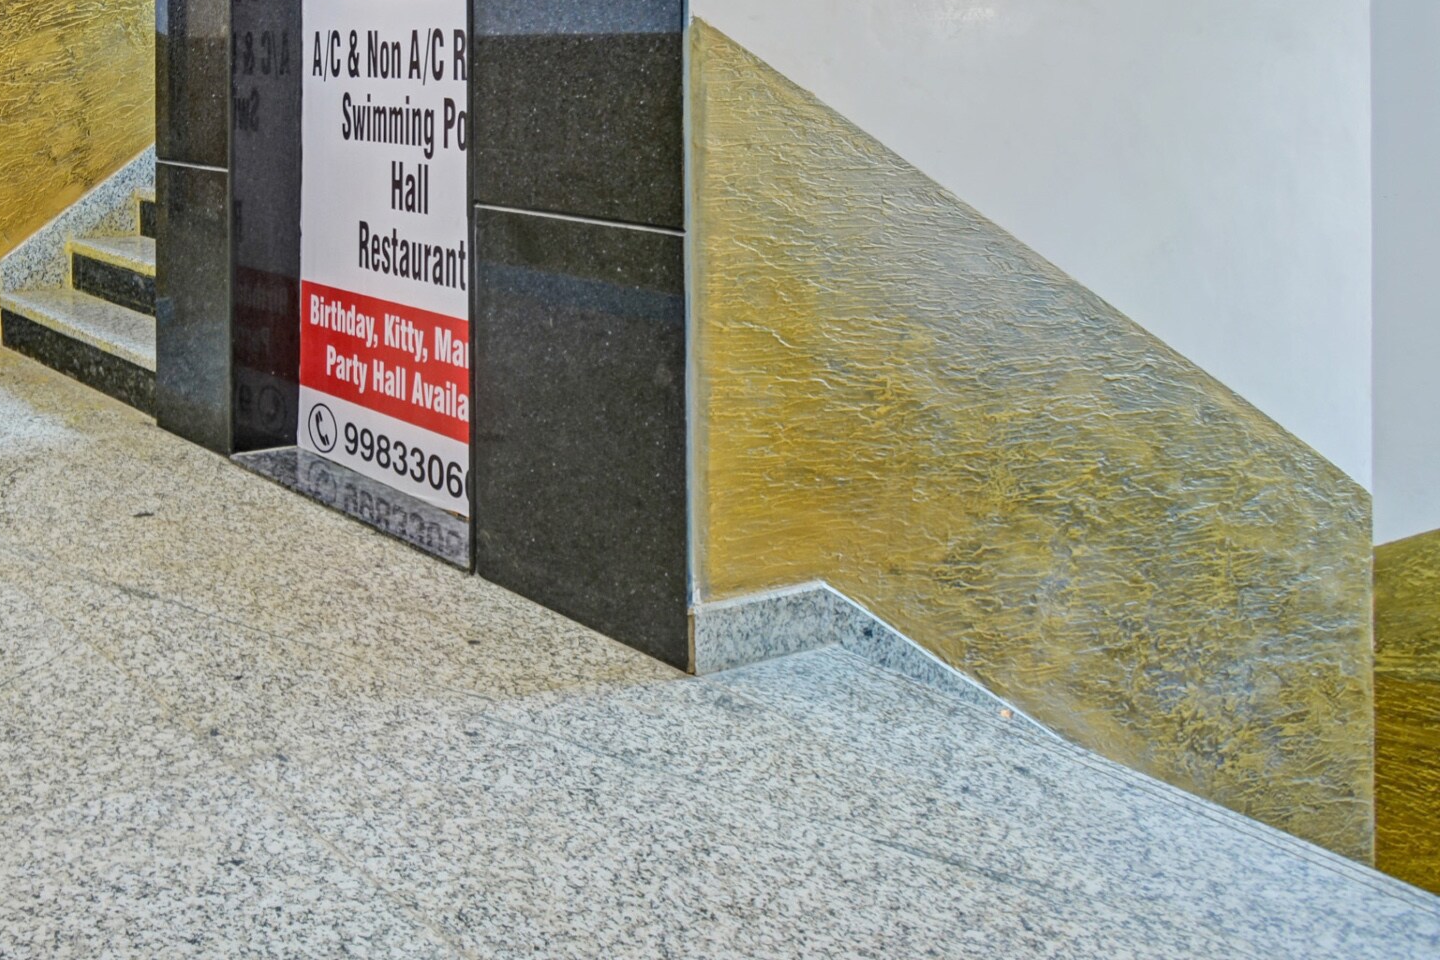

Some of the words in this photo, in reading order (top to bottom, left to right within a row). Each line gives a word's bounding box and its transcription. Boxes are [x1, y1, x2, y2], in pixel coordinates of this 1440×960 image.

[312, 30, 341, 83] A/C
[347, 29, 360, 79] &
[367, 29, 402, 80] Non
[408, 28, 444, 86] A/C
[342, 91, 435, 160] Swimming
[391, 160, 429, 215] Hall
[359, 220, 466, 292] Restaurant
[310, 293, 378, 349] Birthday,
[384, 313, 428, 364] Kitty,
[326, 344, 368, 394] Party
[372, 359, 406, 402] Hall
[411, 371, 469, 423] Availa
[344, 422, 469, 502] 9983306
